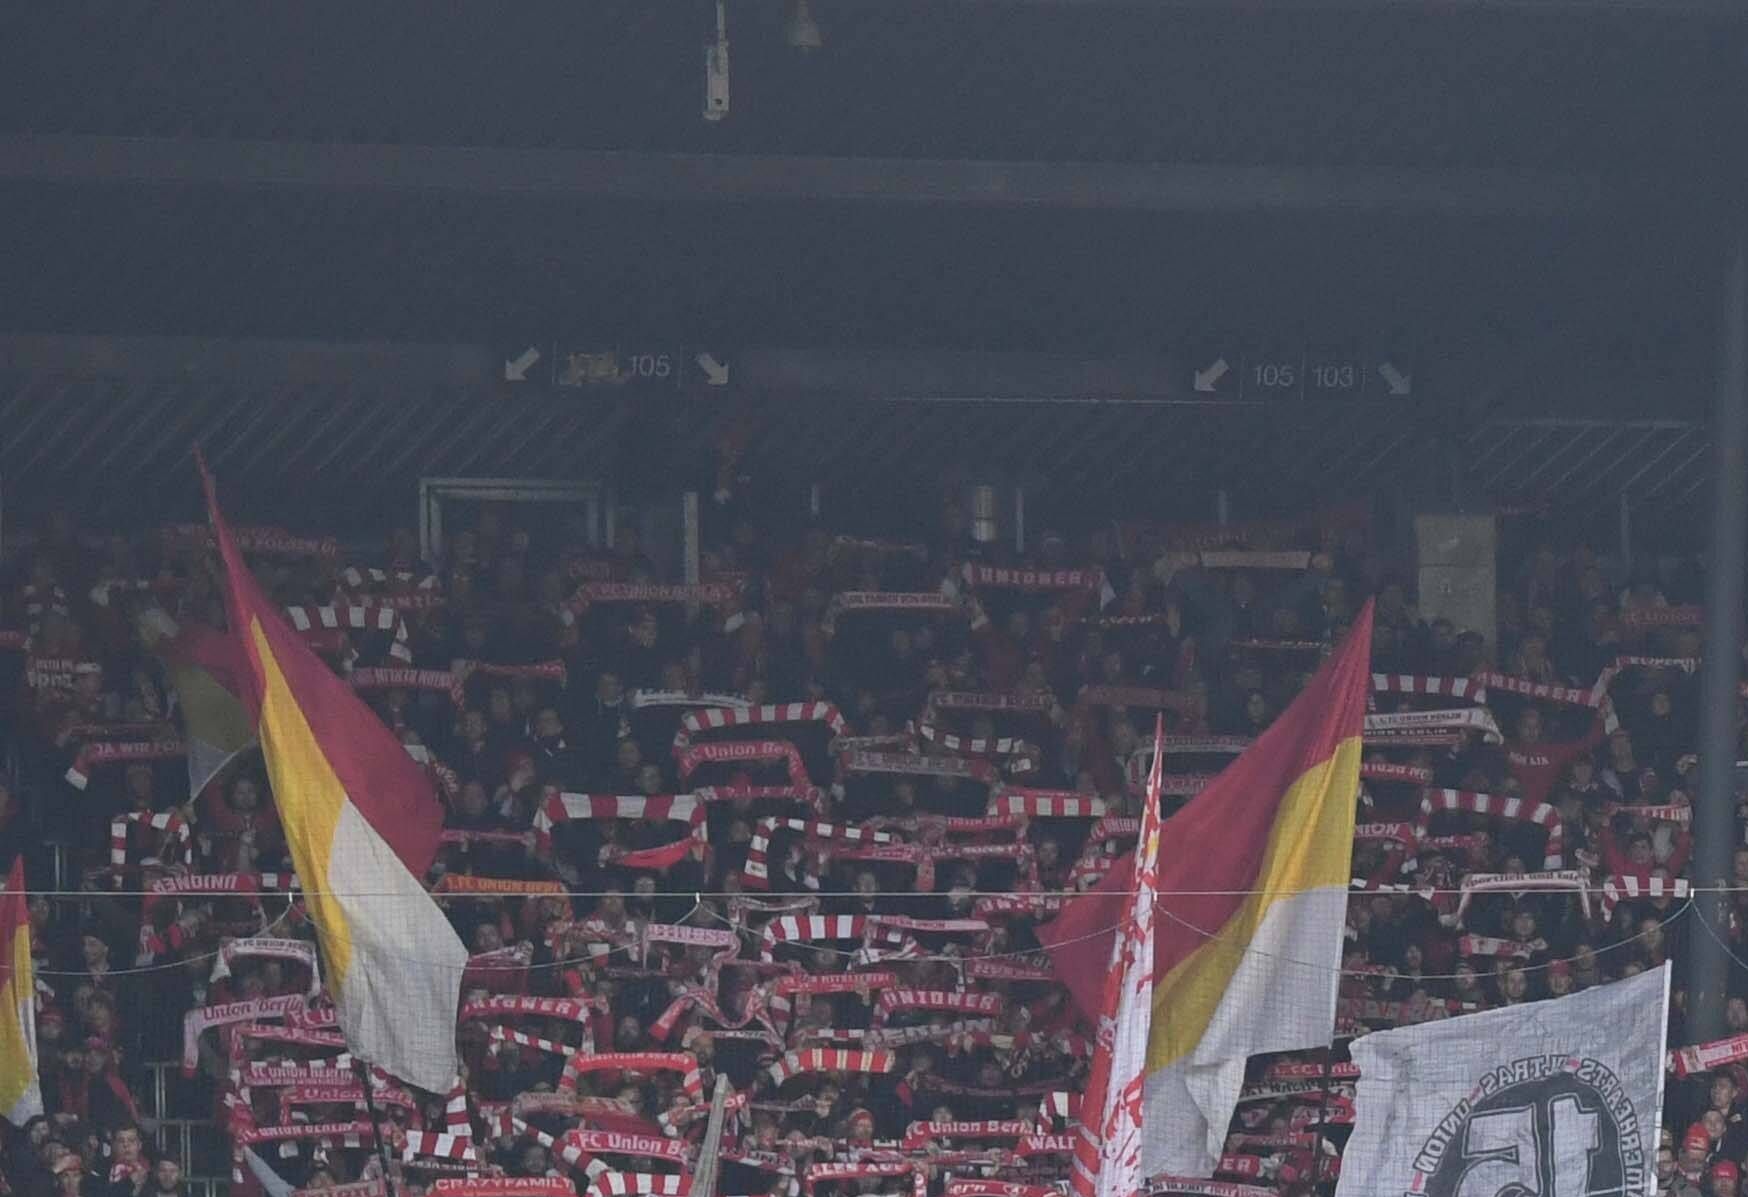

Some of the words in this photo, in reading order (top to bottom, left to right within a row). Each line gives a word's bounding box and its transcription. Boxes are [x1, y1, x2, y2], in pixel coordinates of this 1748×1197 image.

[1253, 364, 1295, 390] 105
[1312, 364, 1355, 390] 103
[605, 1134, 662, 1153] Union
